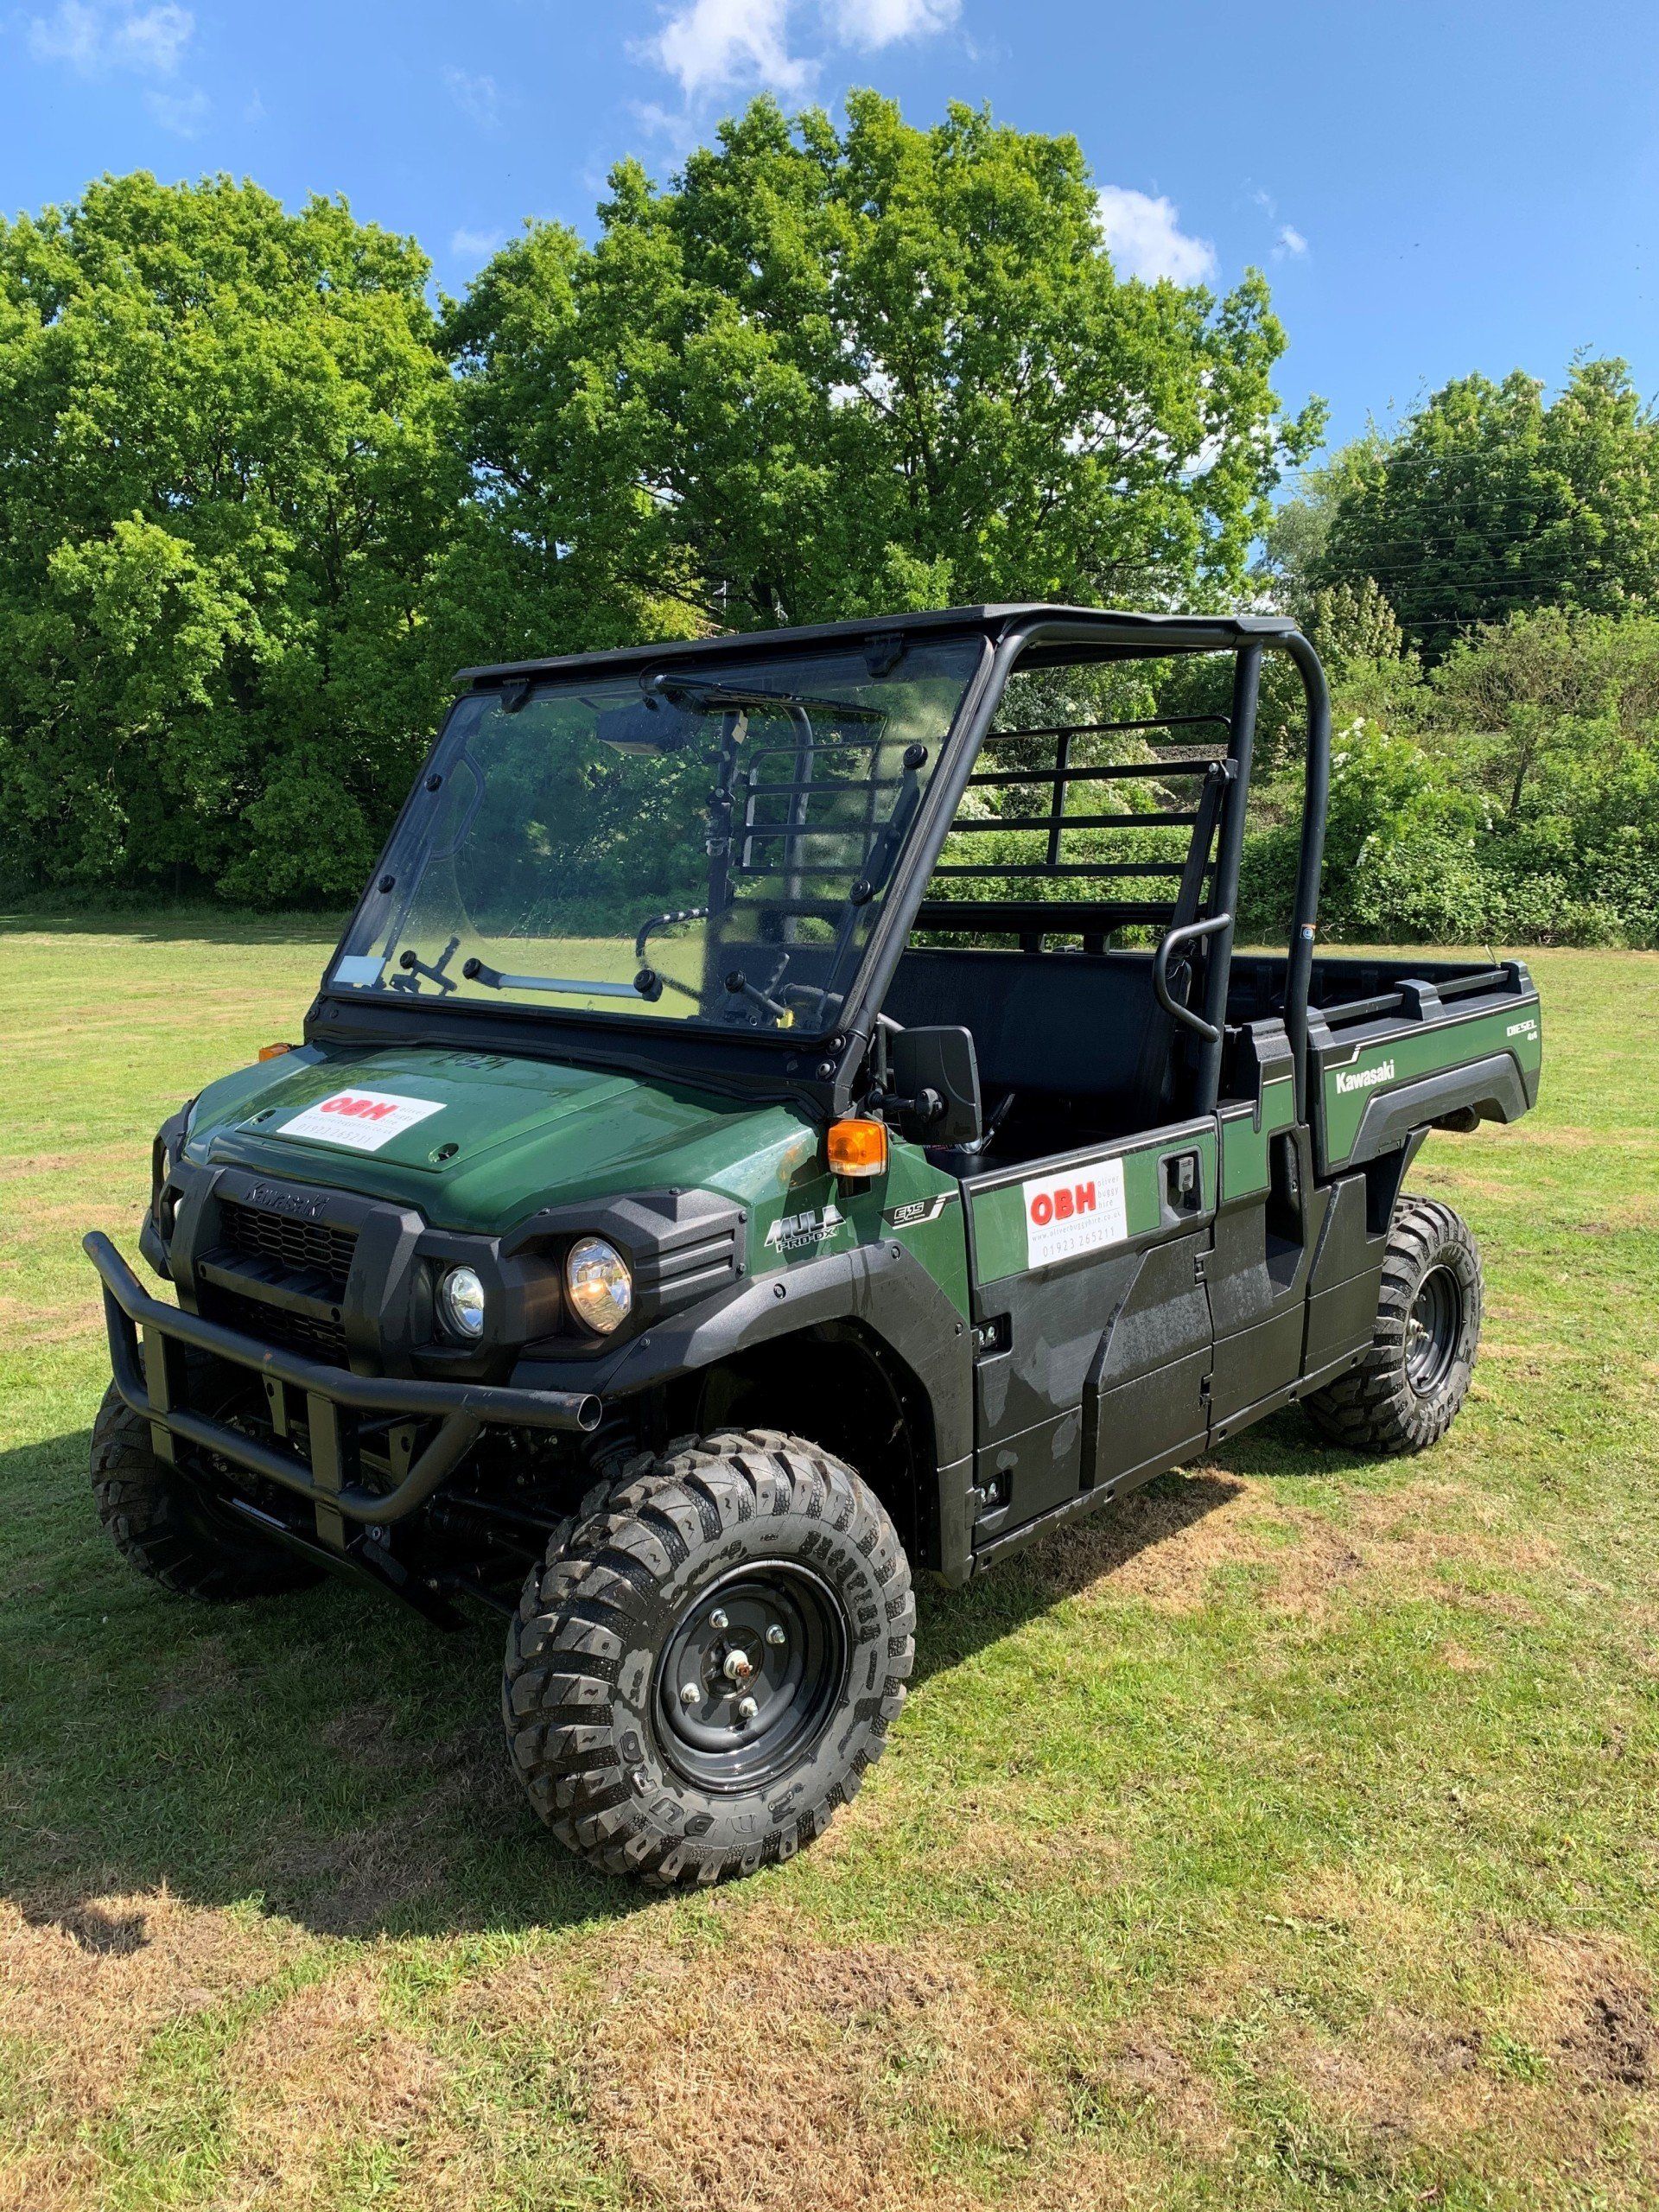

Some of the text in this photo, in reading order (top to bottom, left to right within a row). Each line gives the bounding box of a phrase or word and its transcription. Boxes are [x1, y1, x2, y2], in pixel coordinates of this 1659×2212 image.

[1506, 1019, 1537, 1037] DIESEL
[1336, 1059, 1395, 1094] Kawasaki
[320, 1096, 400, 1121] OBH
[1097, 1175, 1120, 1187] oliver
[1097, 1186, 1119, 1198] buggy
[243, 1180, 330, 1219] Kawasaki
[1030, 1181, 1096, 1225] OBH
[1098, 1198, 1114, 1209] hire
[1032, 1211, 1122, 1243] www.oliverbuggyhire.co.uk
[1042, 1226, 1116, 1258] 01923 265211
